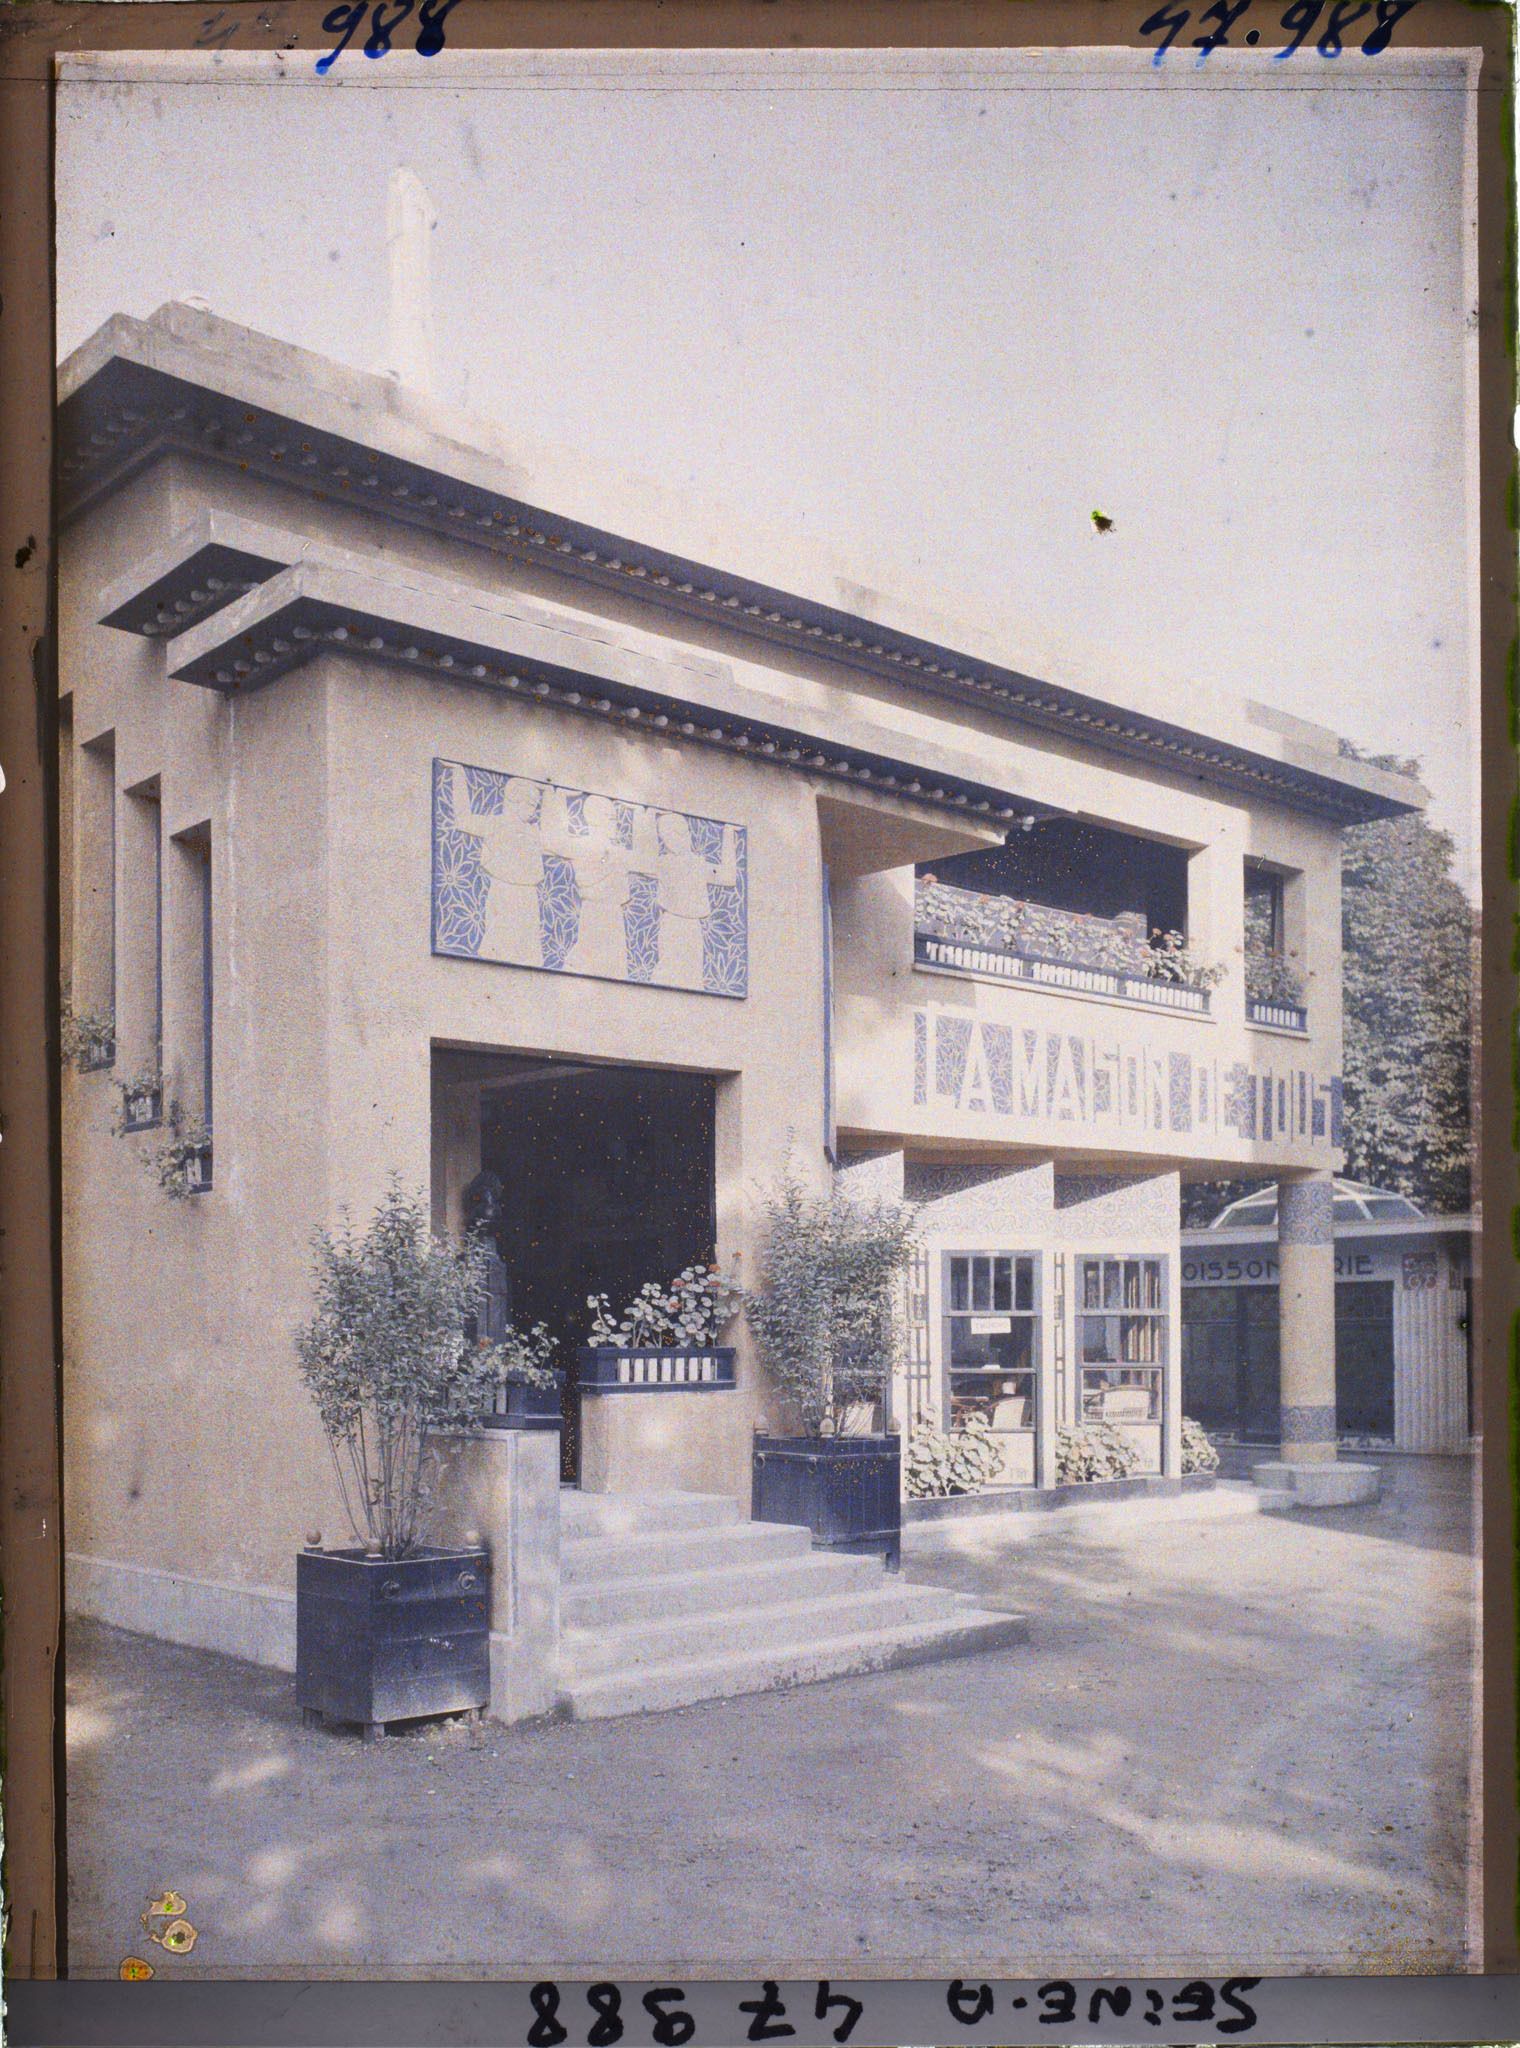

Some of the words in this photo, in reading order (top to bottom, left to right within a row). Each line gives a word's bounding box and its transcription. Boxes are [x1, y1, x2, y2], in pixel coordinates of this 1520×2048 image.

[926, 1010, 995, 1112] LA
[1012, 1025, 1169, 1133] MAISON
[1191, 1054, 1240, 1140] DE
[1248, 1066, 1332, 1148] TOUS
[527, 1981, 695, 2047] 988
